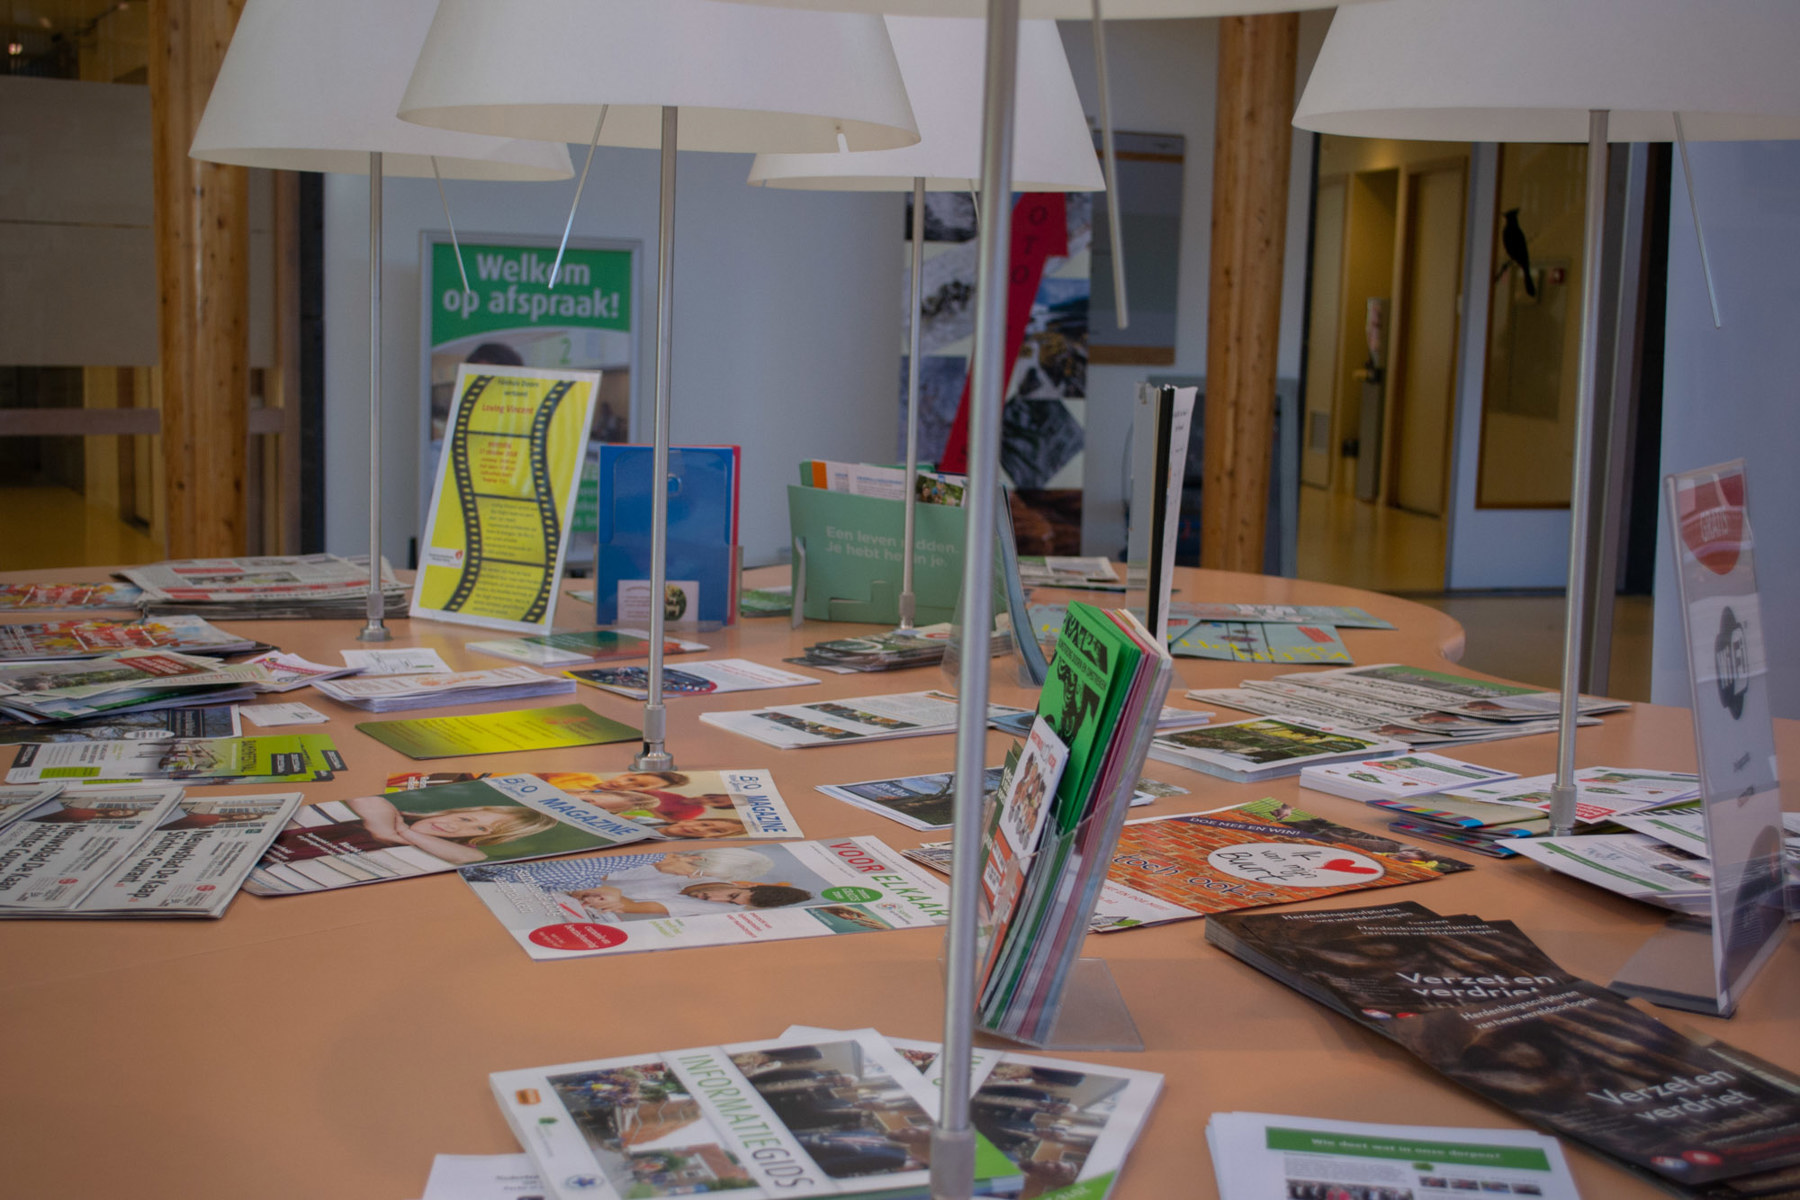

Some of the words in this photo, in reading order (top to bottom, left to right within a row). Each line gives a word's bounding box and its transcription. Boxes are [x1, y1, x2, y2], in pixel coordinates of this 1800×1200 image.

[477, 254, 590, 285] Welkom
[443, 289, 479, 319] op
[488, 285, 620, 322] afspraak!
[825, 541, 842, 553] Je
[847, 544, 881, 560] hebt
[826, 526, 854, 541] Een
[857, 530, 896, 547] leven
[537, 797, 639, 837] MAGAZINE
[745, 795, 788, 834] MAGAZINE
[1189, 816, 1216, 826] DOE
[1217, 819, 1248, 830] MEE
[1249, 823, 1268, 832] EN
[161, 830, 216, 868] Nieuwsblad
[1112, 852, 1180, 877] toch
[150, 869, 179, 879] De
[825, 842, 888, 872] VOOR
[869, 874, 956, 917] ELKAAR
[1215, 850, 1290, 883] Buurt
[1397, 972, 1510, 986] Verzet
[1513, 974, 1555, 985] en
[1586, 1074, 1692, 1106] Verzet
[1694, 1070, 1736, 1087] en
[678, 1053, 815, 1190] INFORMATIEGIDS
[1635, 1088, 1757, 1122] verdriet
